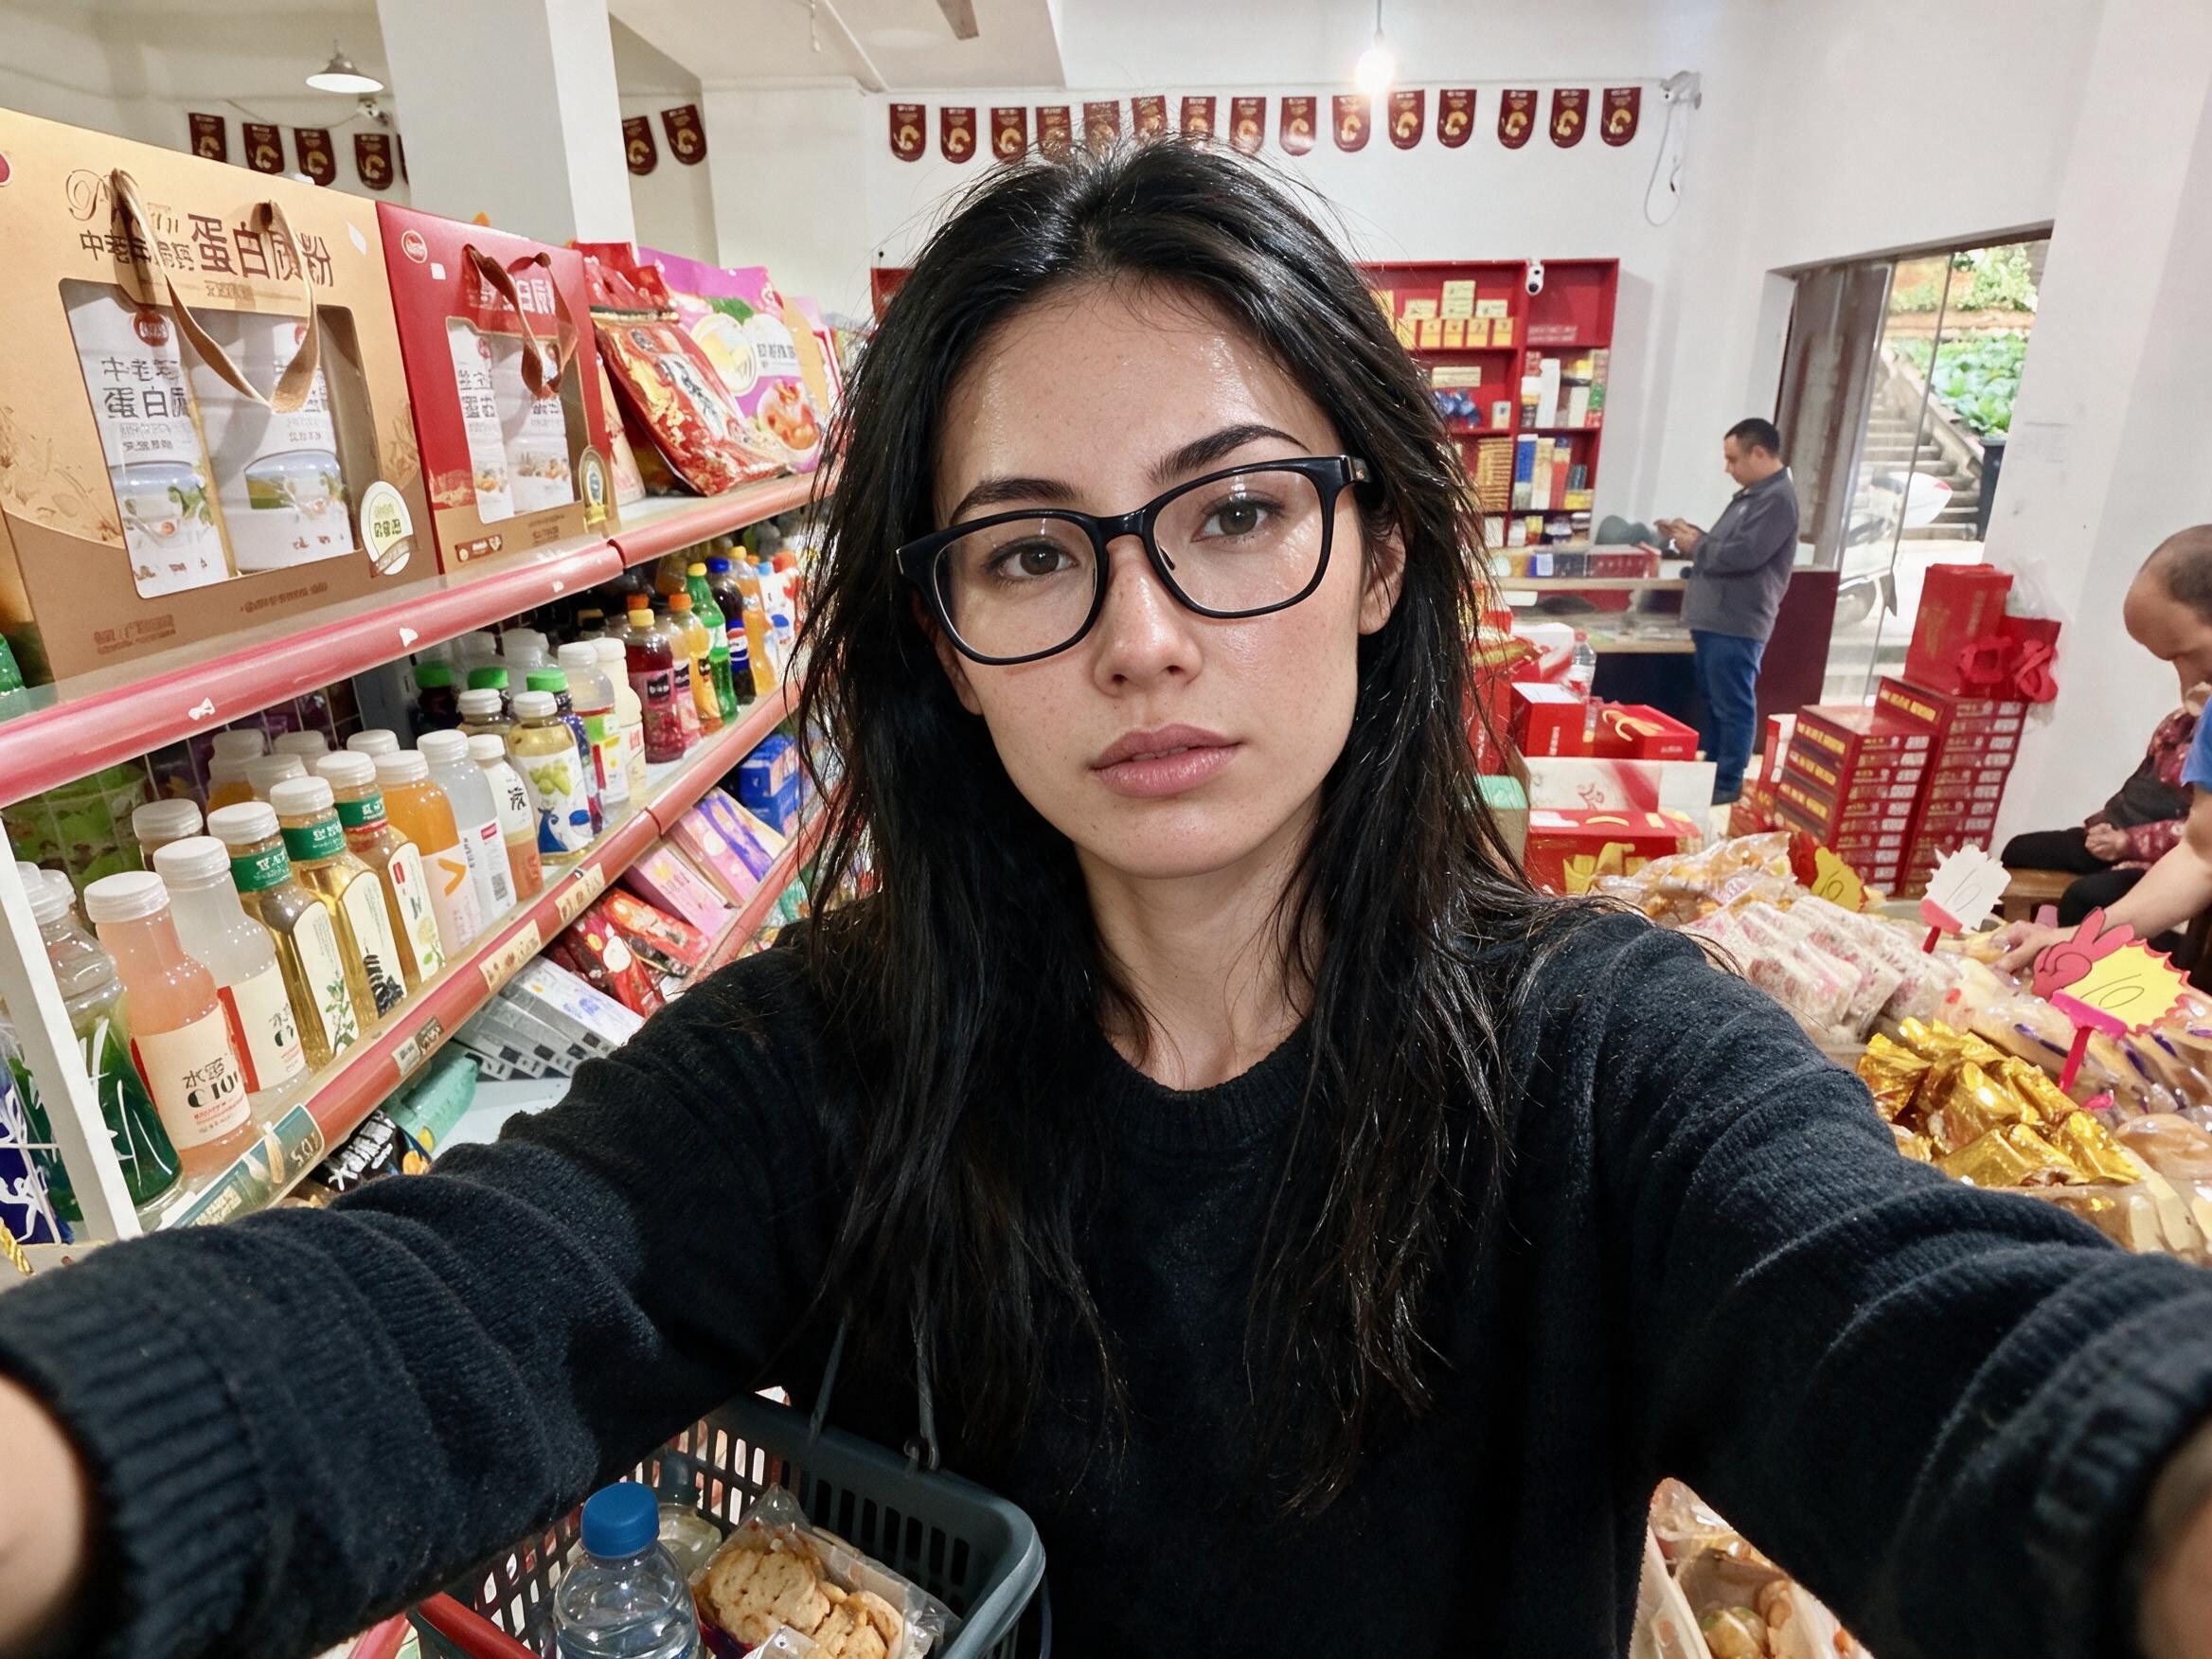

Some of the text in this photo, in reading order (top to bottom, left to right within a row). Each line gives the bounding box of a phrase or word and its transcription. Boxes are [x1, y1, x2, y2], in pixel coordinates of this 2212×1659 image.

[1943, 866, 1983, 913] 10
[2079, 973, 2145, 1010] 10
[187, 1070, 239, 1108] C10
